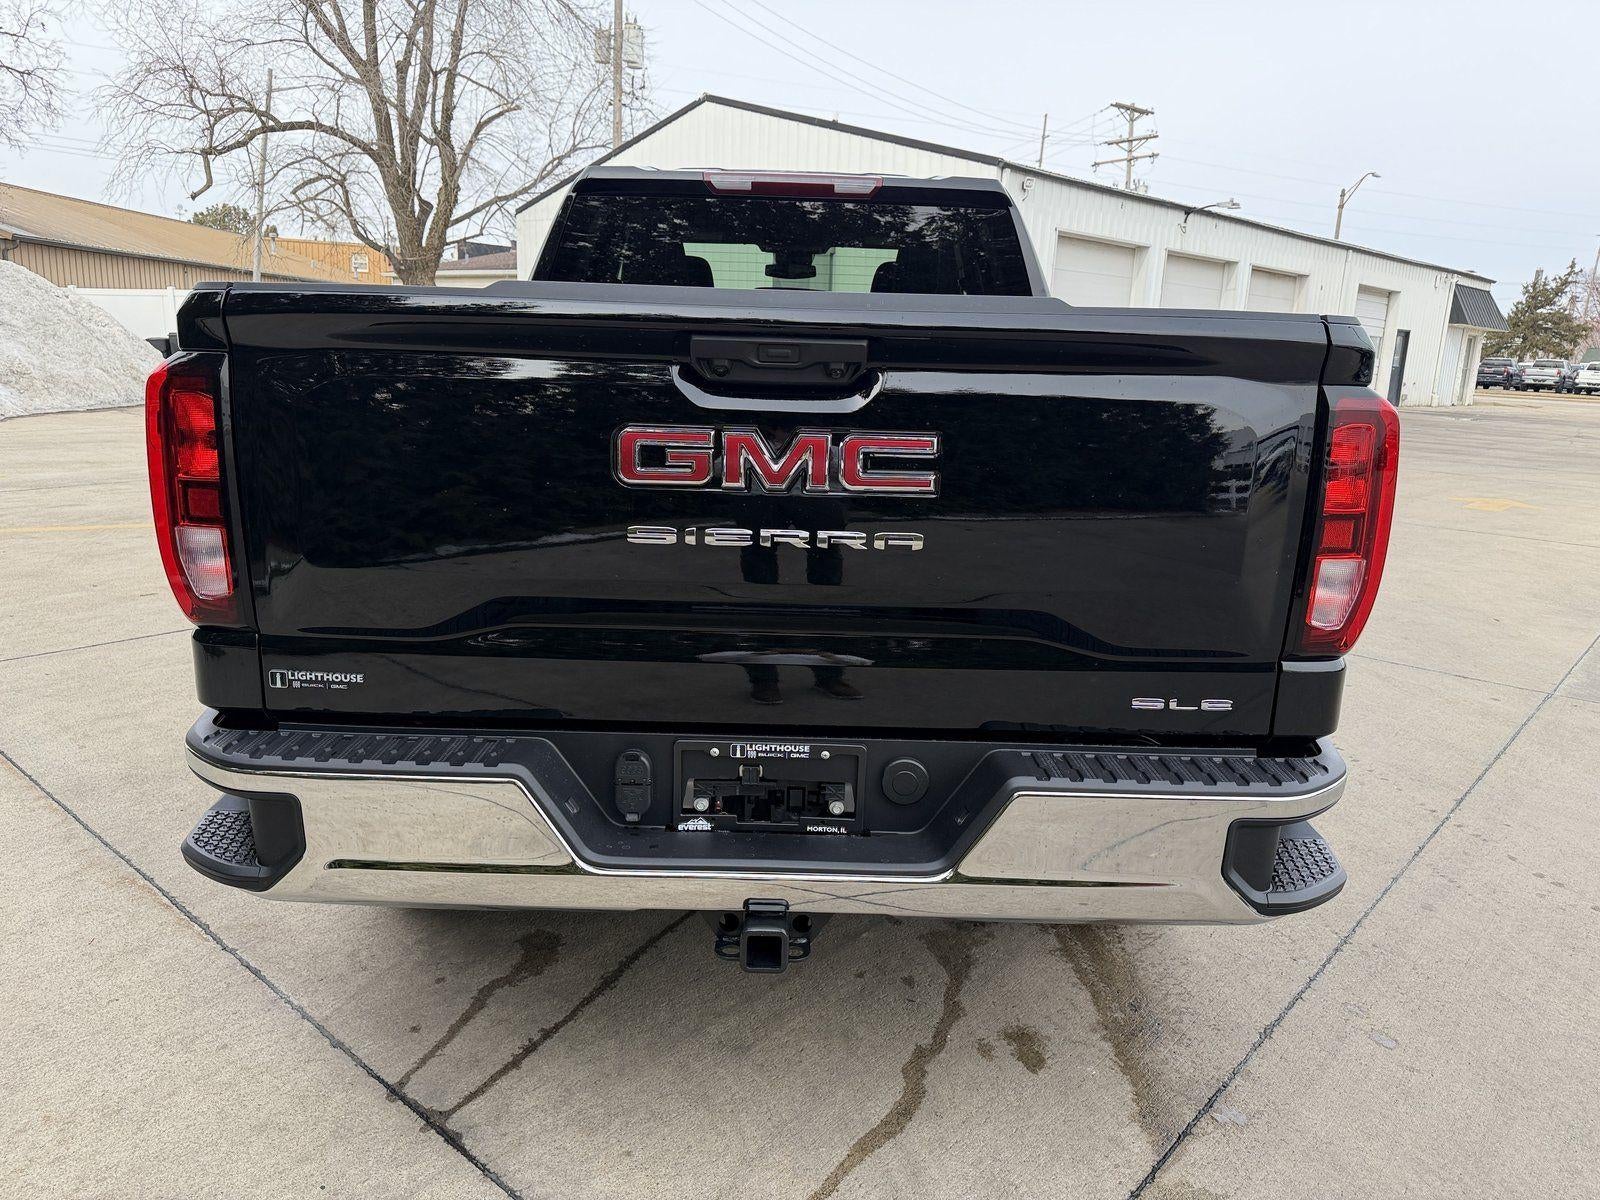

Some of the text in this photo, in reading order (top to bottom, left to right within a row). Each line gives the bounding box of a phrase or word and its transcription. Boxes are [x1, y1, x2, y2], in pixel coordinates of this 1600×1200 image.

[613, 424, 940, 497] GMC
[626, 525, 925, 551] SIERRA
[288, 671, 364, 683] LIGHTHOUSE
[1131, 697, 1234, 711] SLE
[747, 744, 810, 752] LIGHTHOUSE
[678, 823, 711, 831] everest
[807, 826, 839, 834] MORTON,
